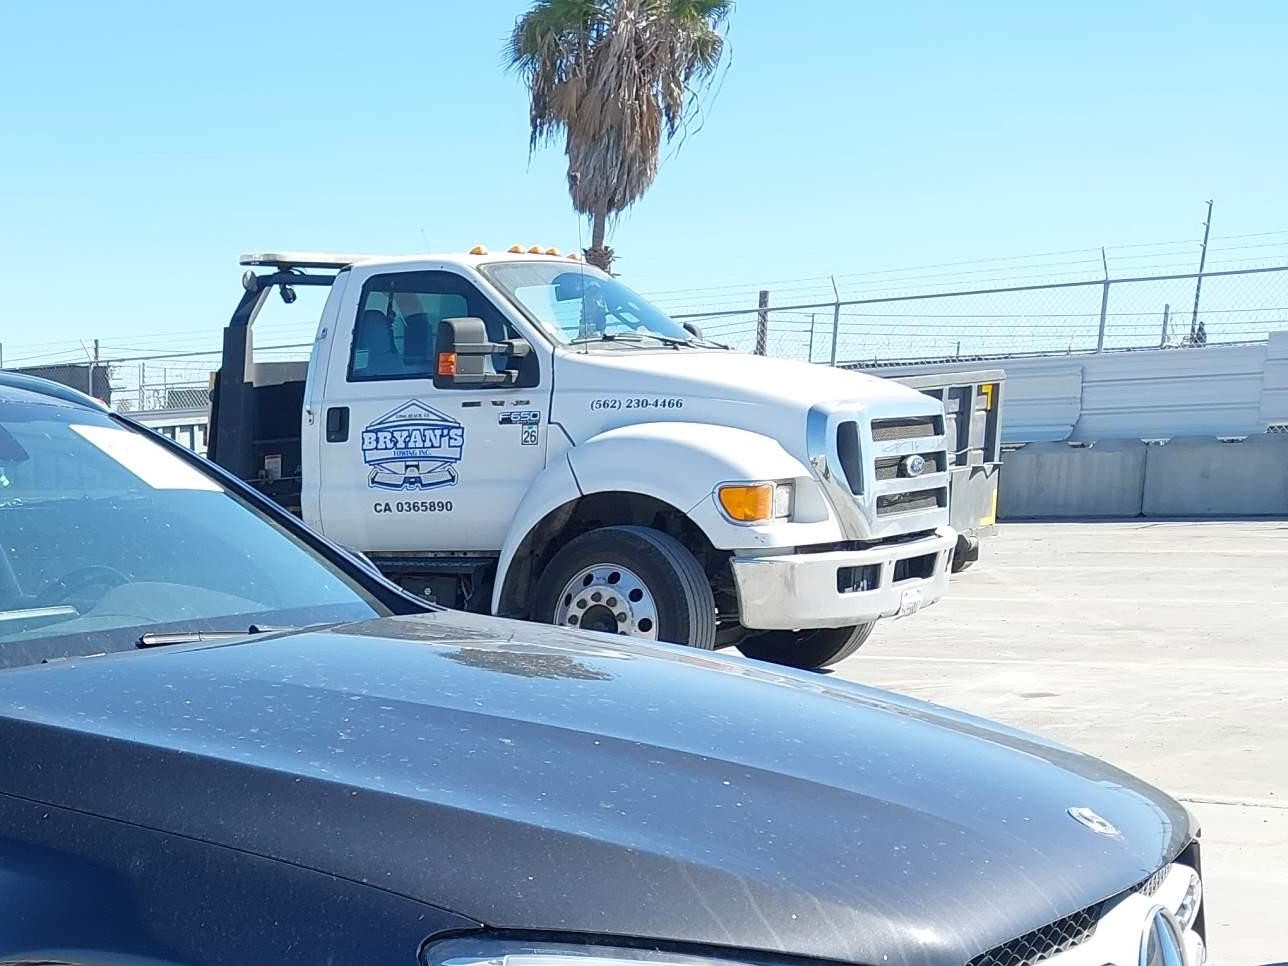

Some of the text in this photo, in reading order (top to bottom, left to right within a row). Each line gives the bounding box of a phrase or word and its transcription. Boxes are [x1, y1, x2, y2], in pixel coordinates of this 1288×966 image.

[590, 398, 683, 411] (562) 230-4466
[362, 427, 464, 450] BRYAN'S
[523, 429, 537, 443] 26
[373, 500, 454, 514] CA 0365890
